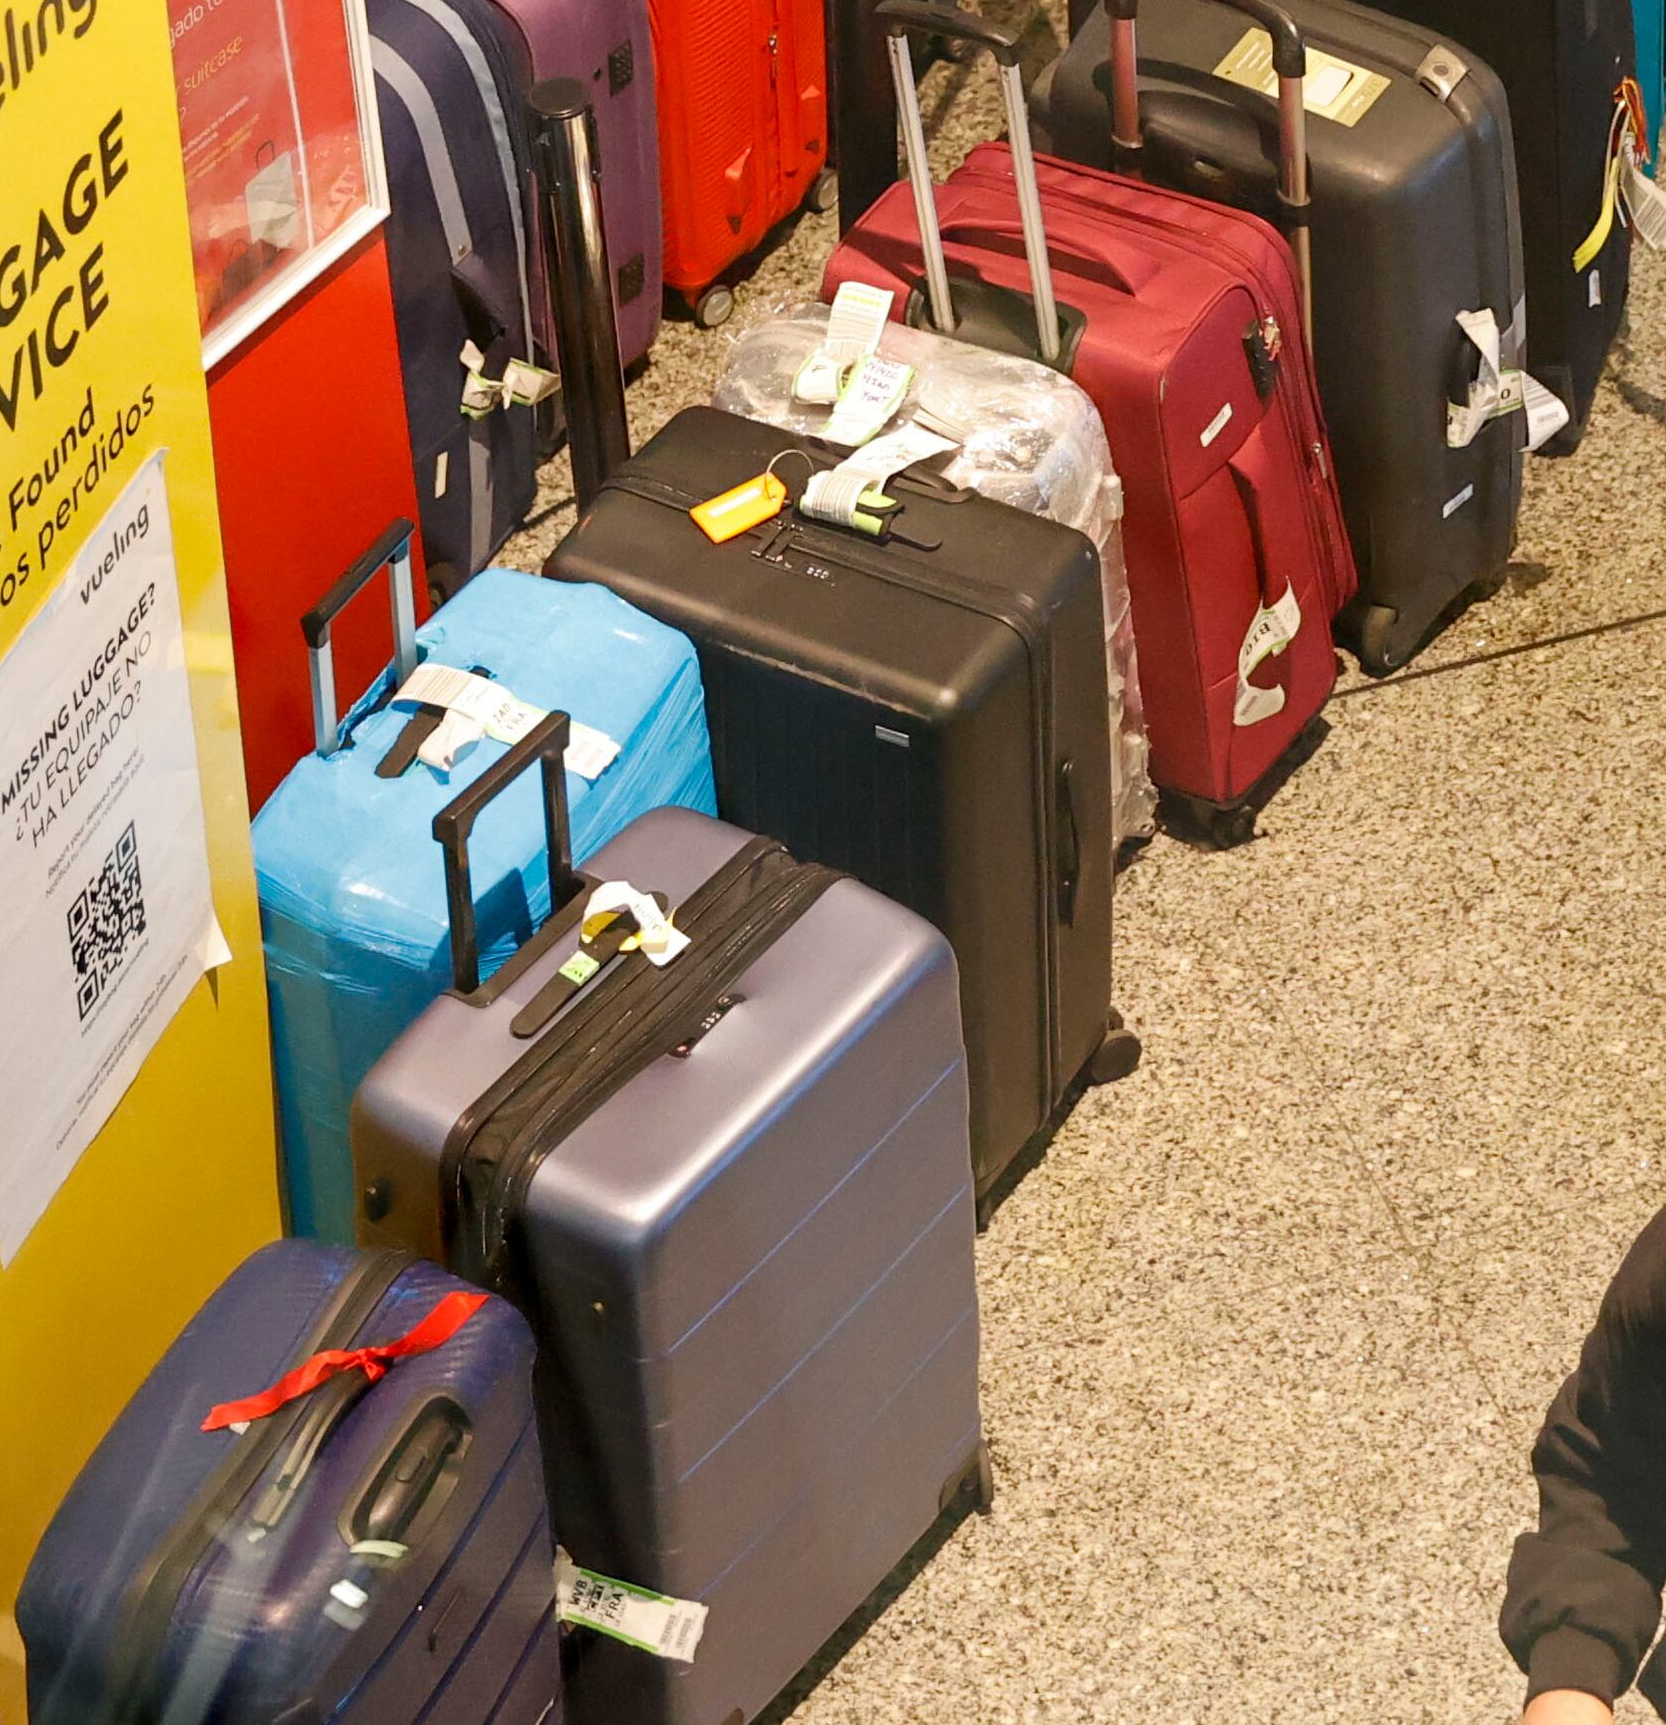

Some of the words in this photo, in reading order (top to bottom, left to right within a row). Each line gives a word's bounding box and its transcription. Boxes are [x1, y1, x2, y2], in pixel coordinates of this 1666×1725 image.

[183, 35, 243, 95] suitcase
[8, 387, 94, 530] Found
[37, 385, 154, 569] perdidos
[80, 504, 150, 606] vueling
[0, 704, 69, 813] MISSING
[72, 582, 155, 710] LUGGAGE?
[15, 781, 41, 842] ¿TU
[44, 669, 121, 789] EQUIPAJE
[124, 630, 151, 677] NO
[31, 805, 58, 848] HA
[59, 679, 141, 808] LLEGADO?
[605, 1591, 625, 1620] FRA
